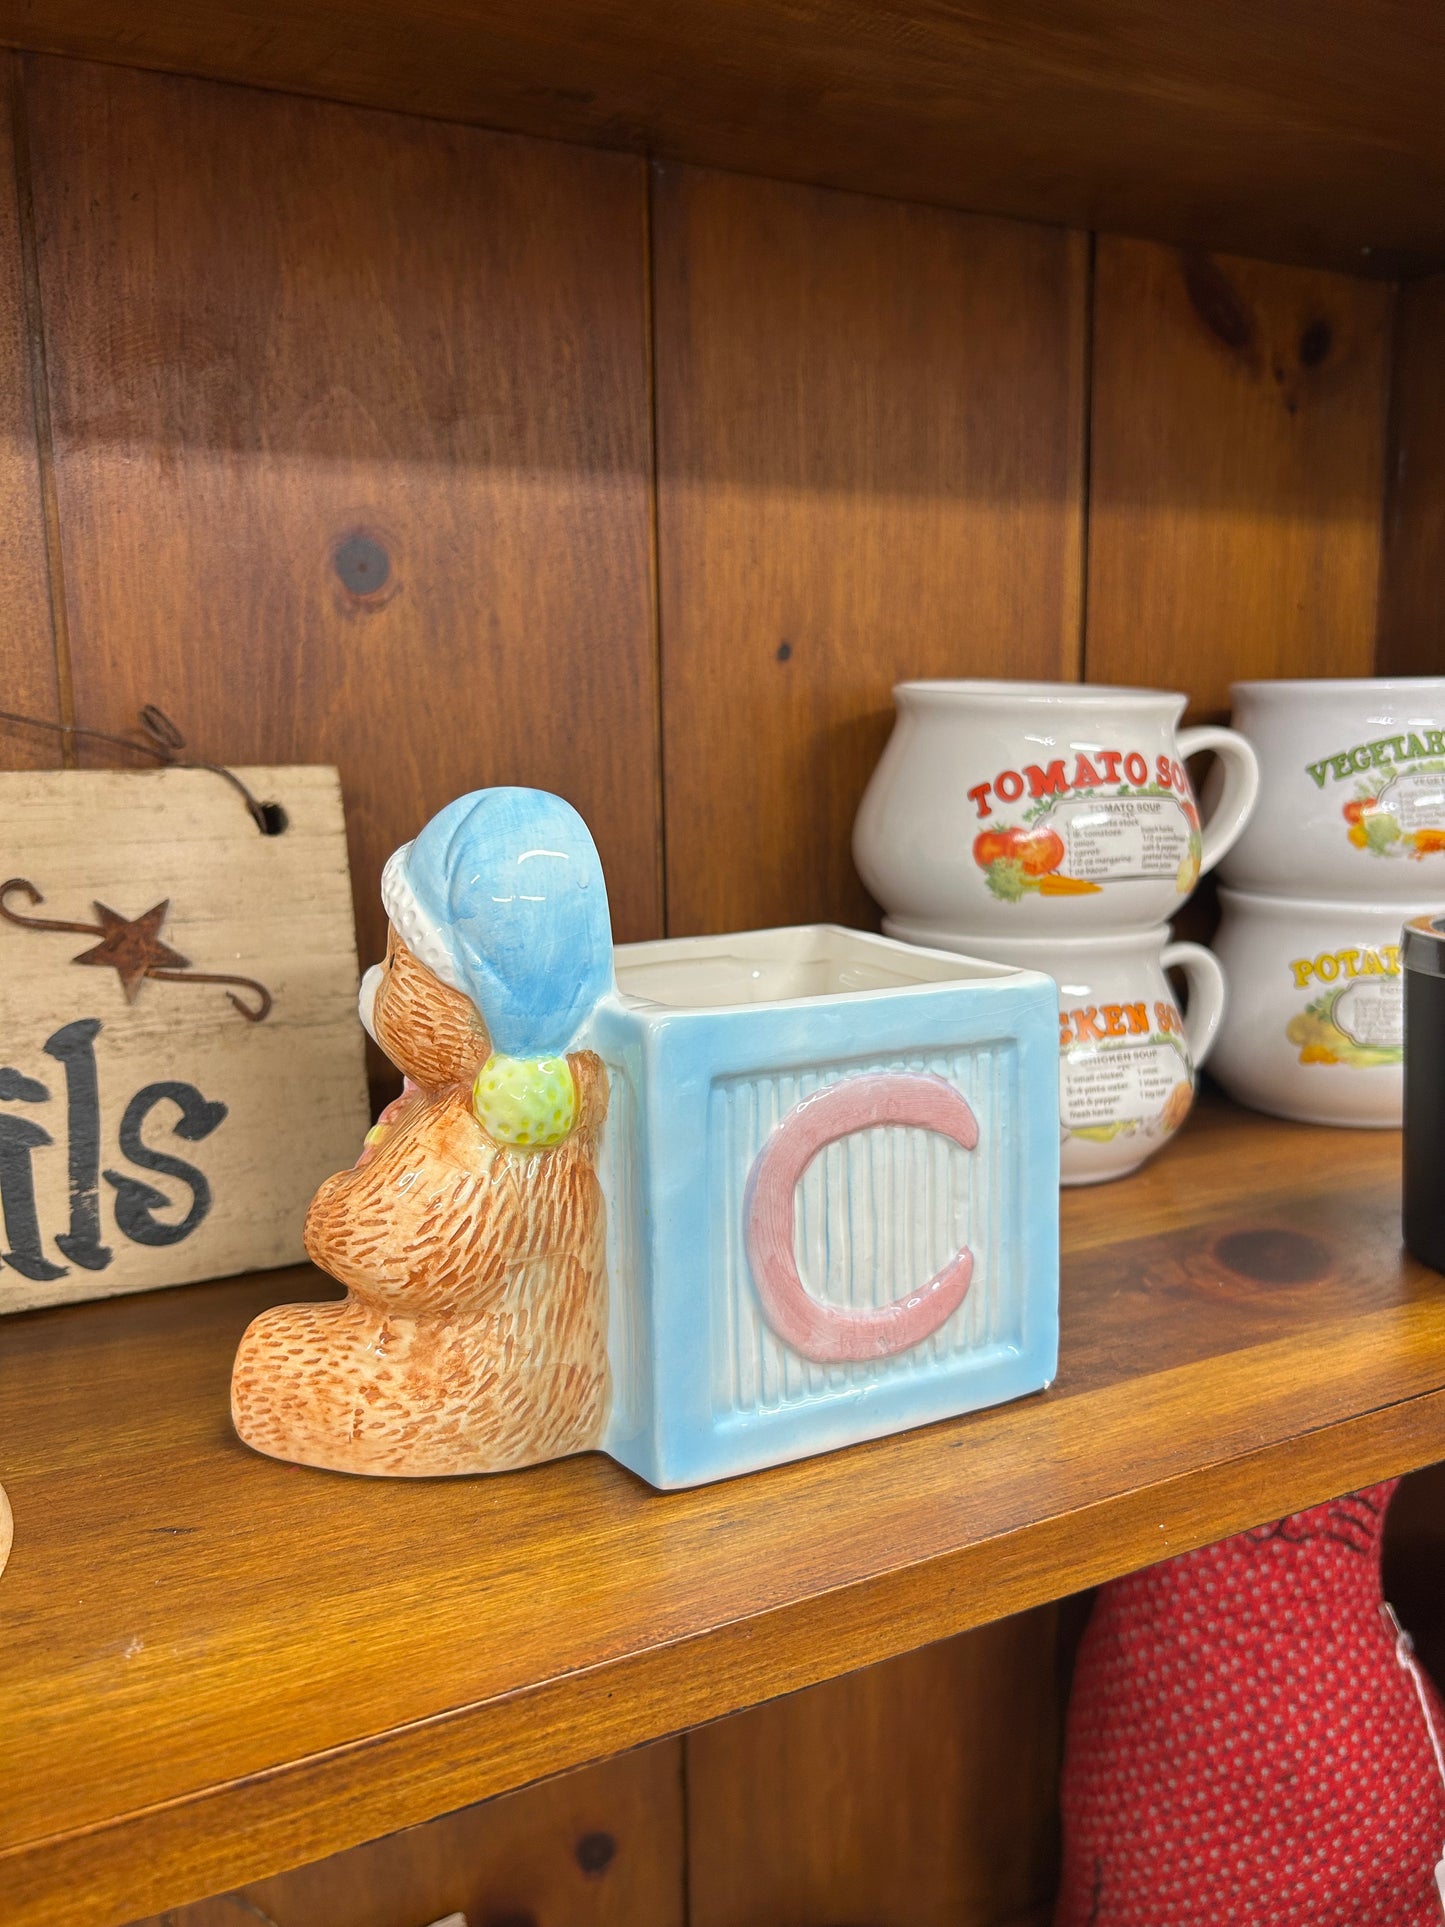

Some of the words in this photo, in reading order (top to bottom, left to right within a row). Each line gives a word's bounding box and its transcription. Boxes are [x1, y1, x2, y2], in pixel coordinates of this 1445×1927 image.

[968, 751, 1148, 818] TOMATO
[1156, 754, 1194, 800] SO
[1089, 803, 1134, 813] TOMATO
[1137, 803, 1161, 812] SOUP
[1084, 829, 1121, 838] tomatoes
[1154, 1001, 1185, 1034] SO
[1133, 1050, 1157, 1060] SOUP
[742, 1070, 979, 1364] C
